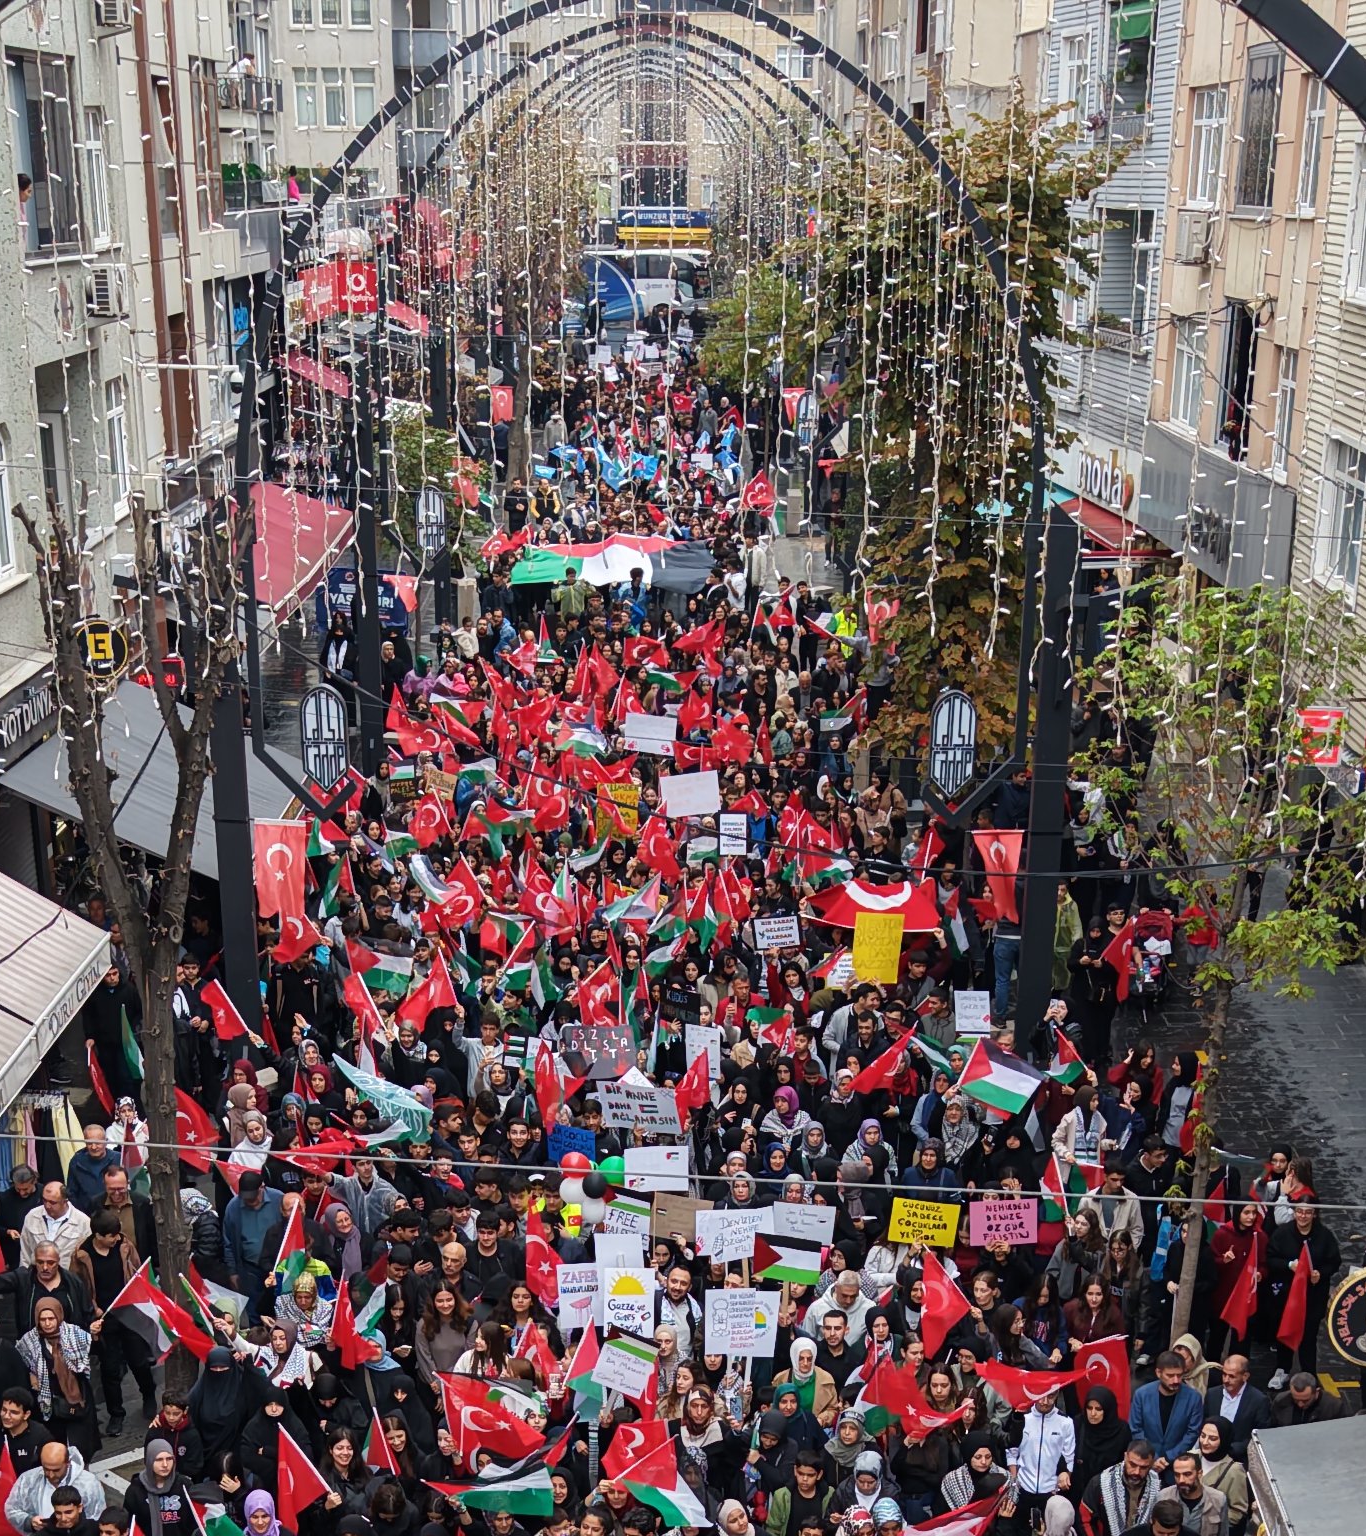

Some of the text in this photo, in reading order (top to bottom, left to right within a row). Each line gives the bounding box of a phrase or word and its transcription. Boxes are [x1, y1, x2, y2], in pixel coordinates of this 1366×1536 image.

[625, 1090, 657, 1102] ANNE
[608, 1101, 632, 1111] DAHA
[607, 1208, 641, 1230] FREE
[906, 1209, 944, 1222] SADECE
